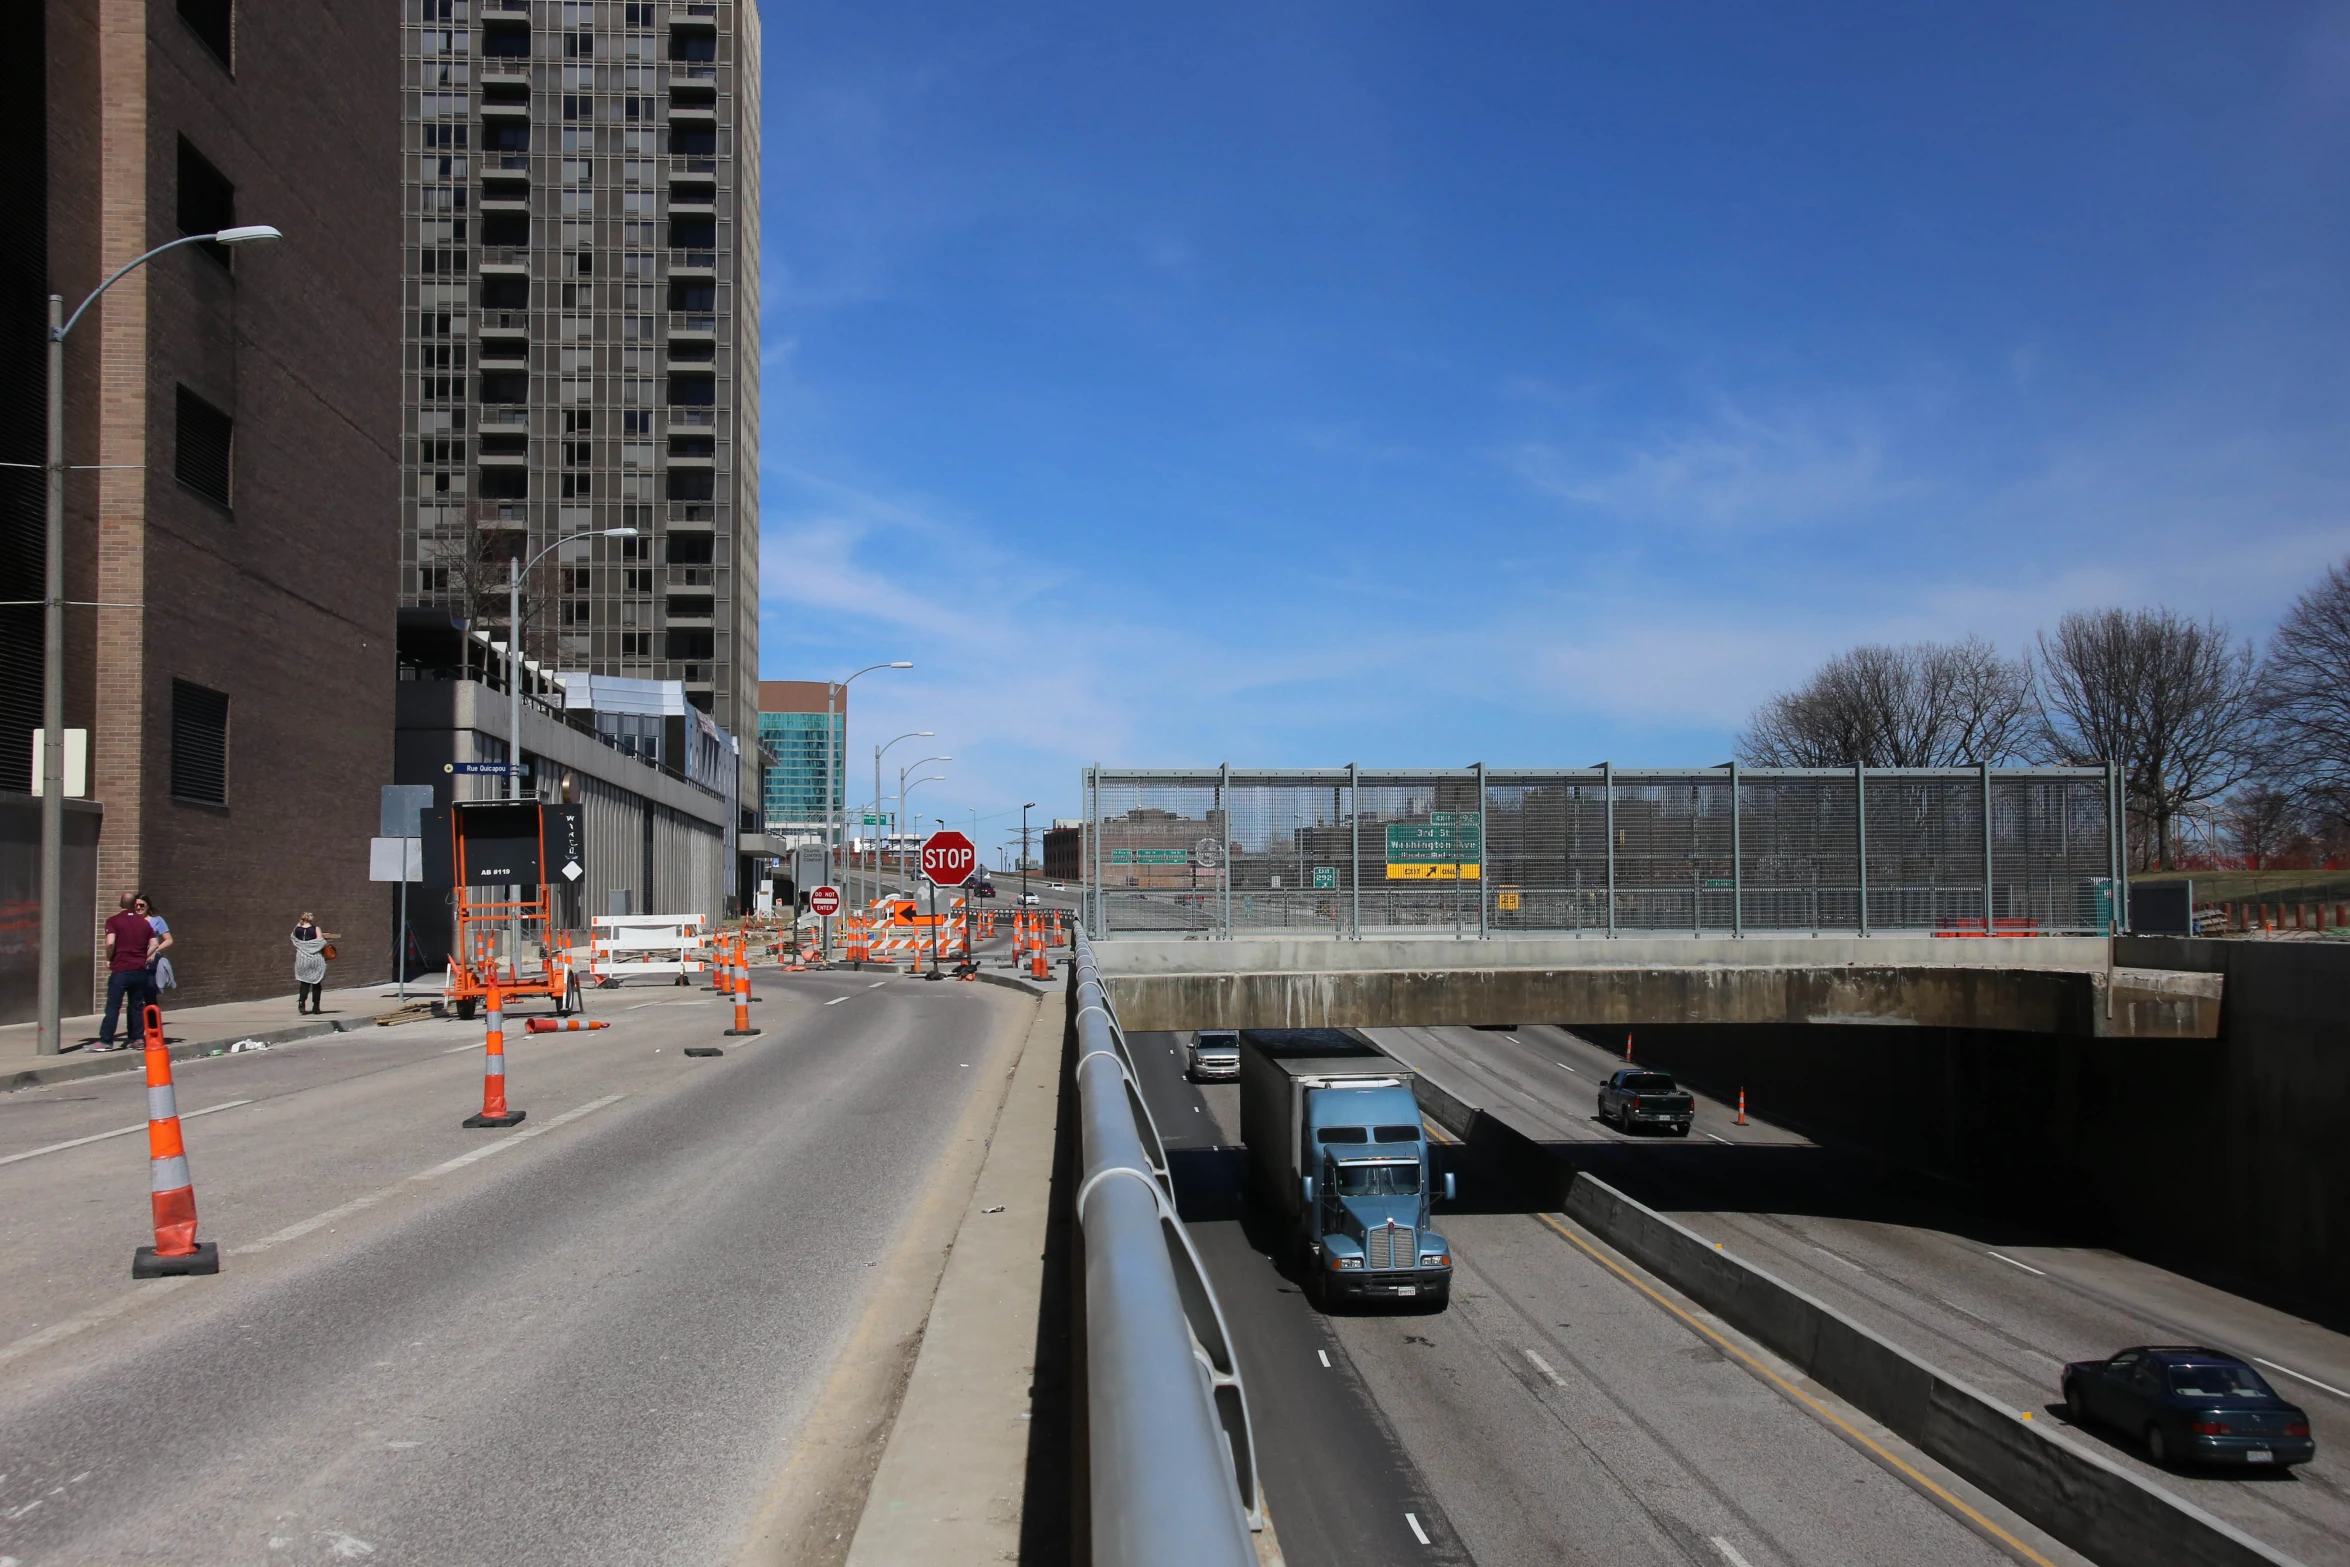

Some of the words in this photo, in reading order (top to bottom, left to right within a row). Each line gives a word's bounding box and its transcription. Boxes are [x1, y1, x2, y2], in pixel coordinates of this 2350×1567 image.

[466, 764, 478, 772] Rue
[479, 764, 506, 773] Quicapou
[1417, 828, 1433, 837] 3rd
[1440, 828, 1450, 837] St
[1391, 841, 1451, 851] Washington
[925, 848, 972, 869] STOP
[1442, 867, 1462, 875] ONL
